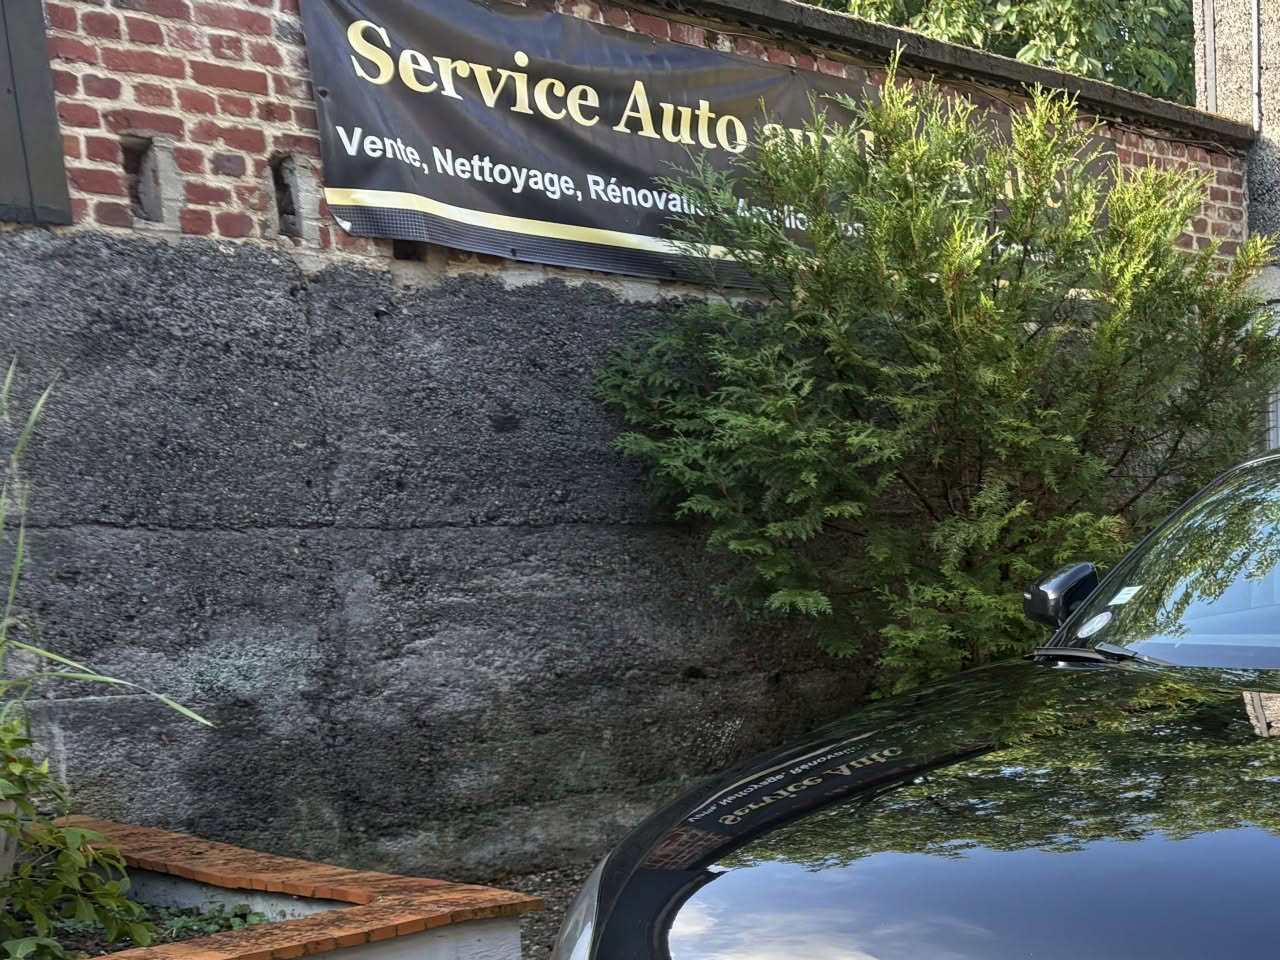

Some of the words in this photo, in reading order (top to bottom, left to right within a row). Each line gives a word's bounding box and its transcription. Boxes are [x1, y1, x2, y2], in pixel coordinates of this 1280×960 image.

[346, 19, 600, 128] Service
[613, 80, 747, 154] Auto
[336, 125, 429, 175] Vente,
[432, 146, 583, 202] Nettoyage,
